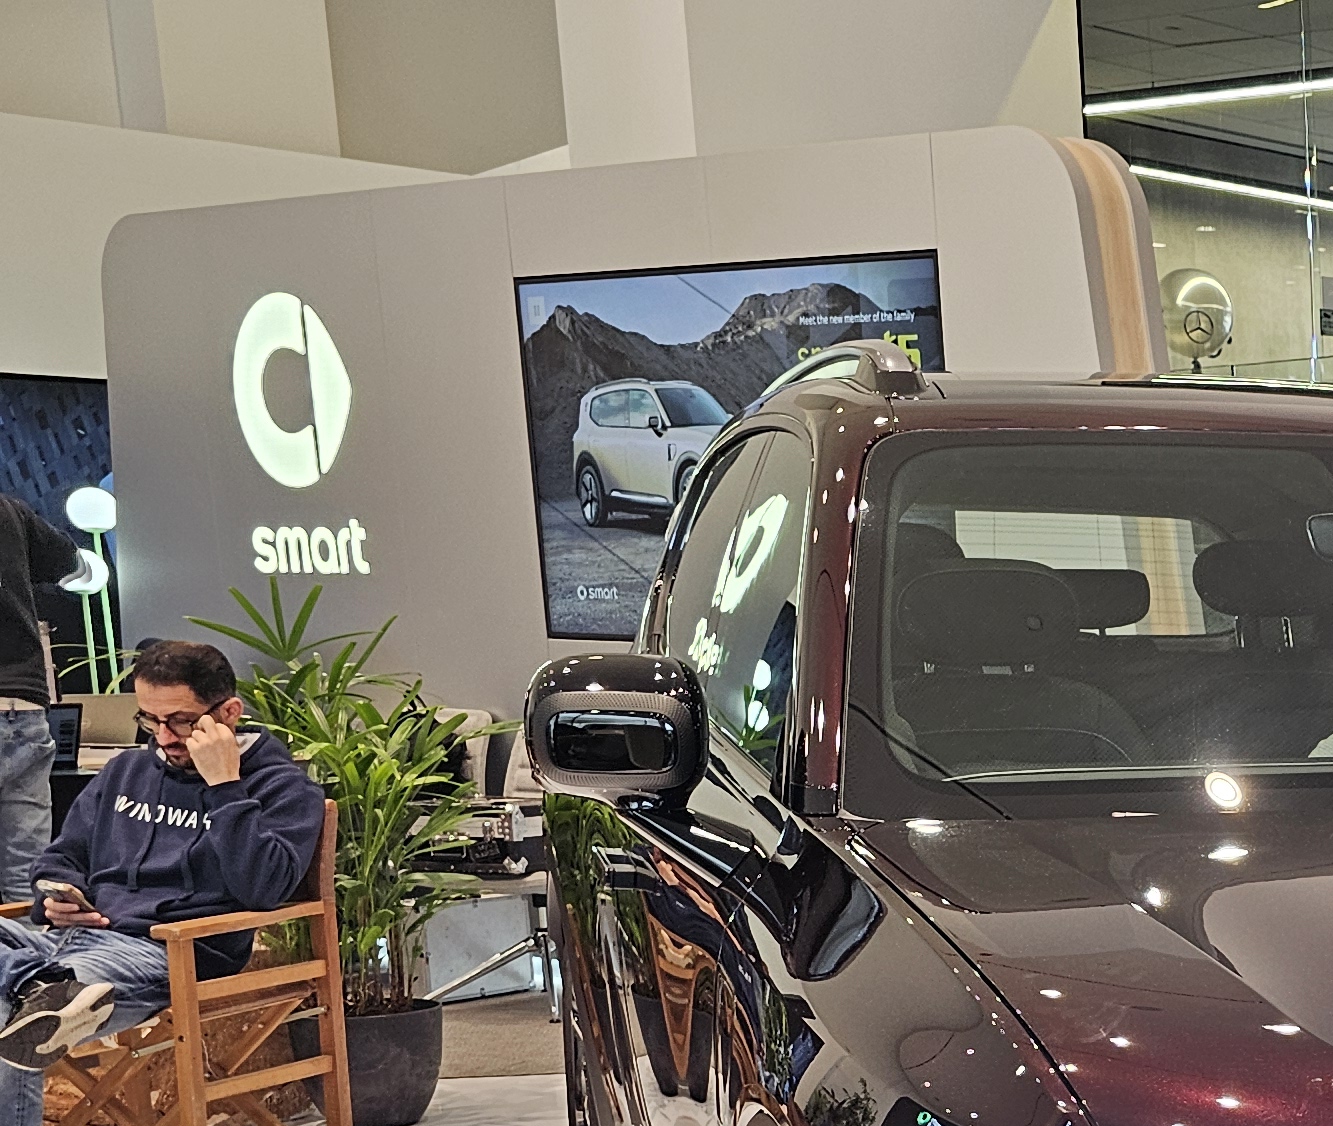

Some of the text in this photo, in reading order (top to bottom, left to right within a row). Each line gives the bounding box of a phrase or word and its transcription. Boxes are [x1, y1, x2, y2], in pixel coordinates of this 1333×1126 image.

[799, 309, 915, 326] Meet the new member of the family
[252, 518, 371, 575] smart
[588, 585, 619, 601] smart
